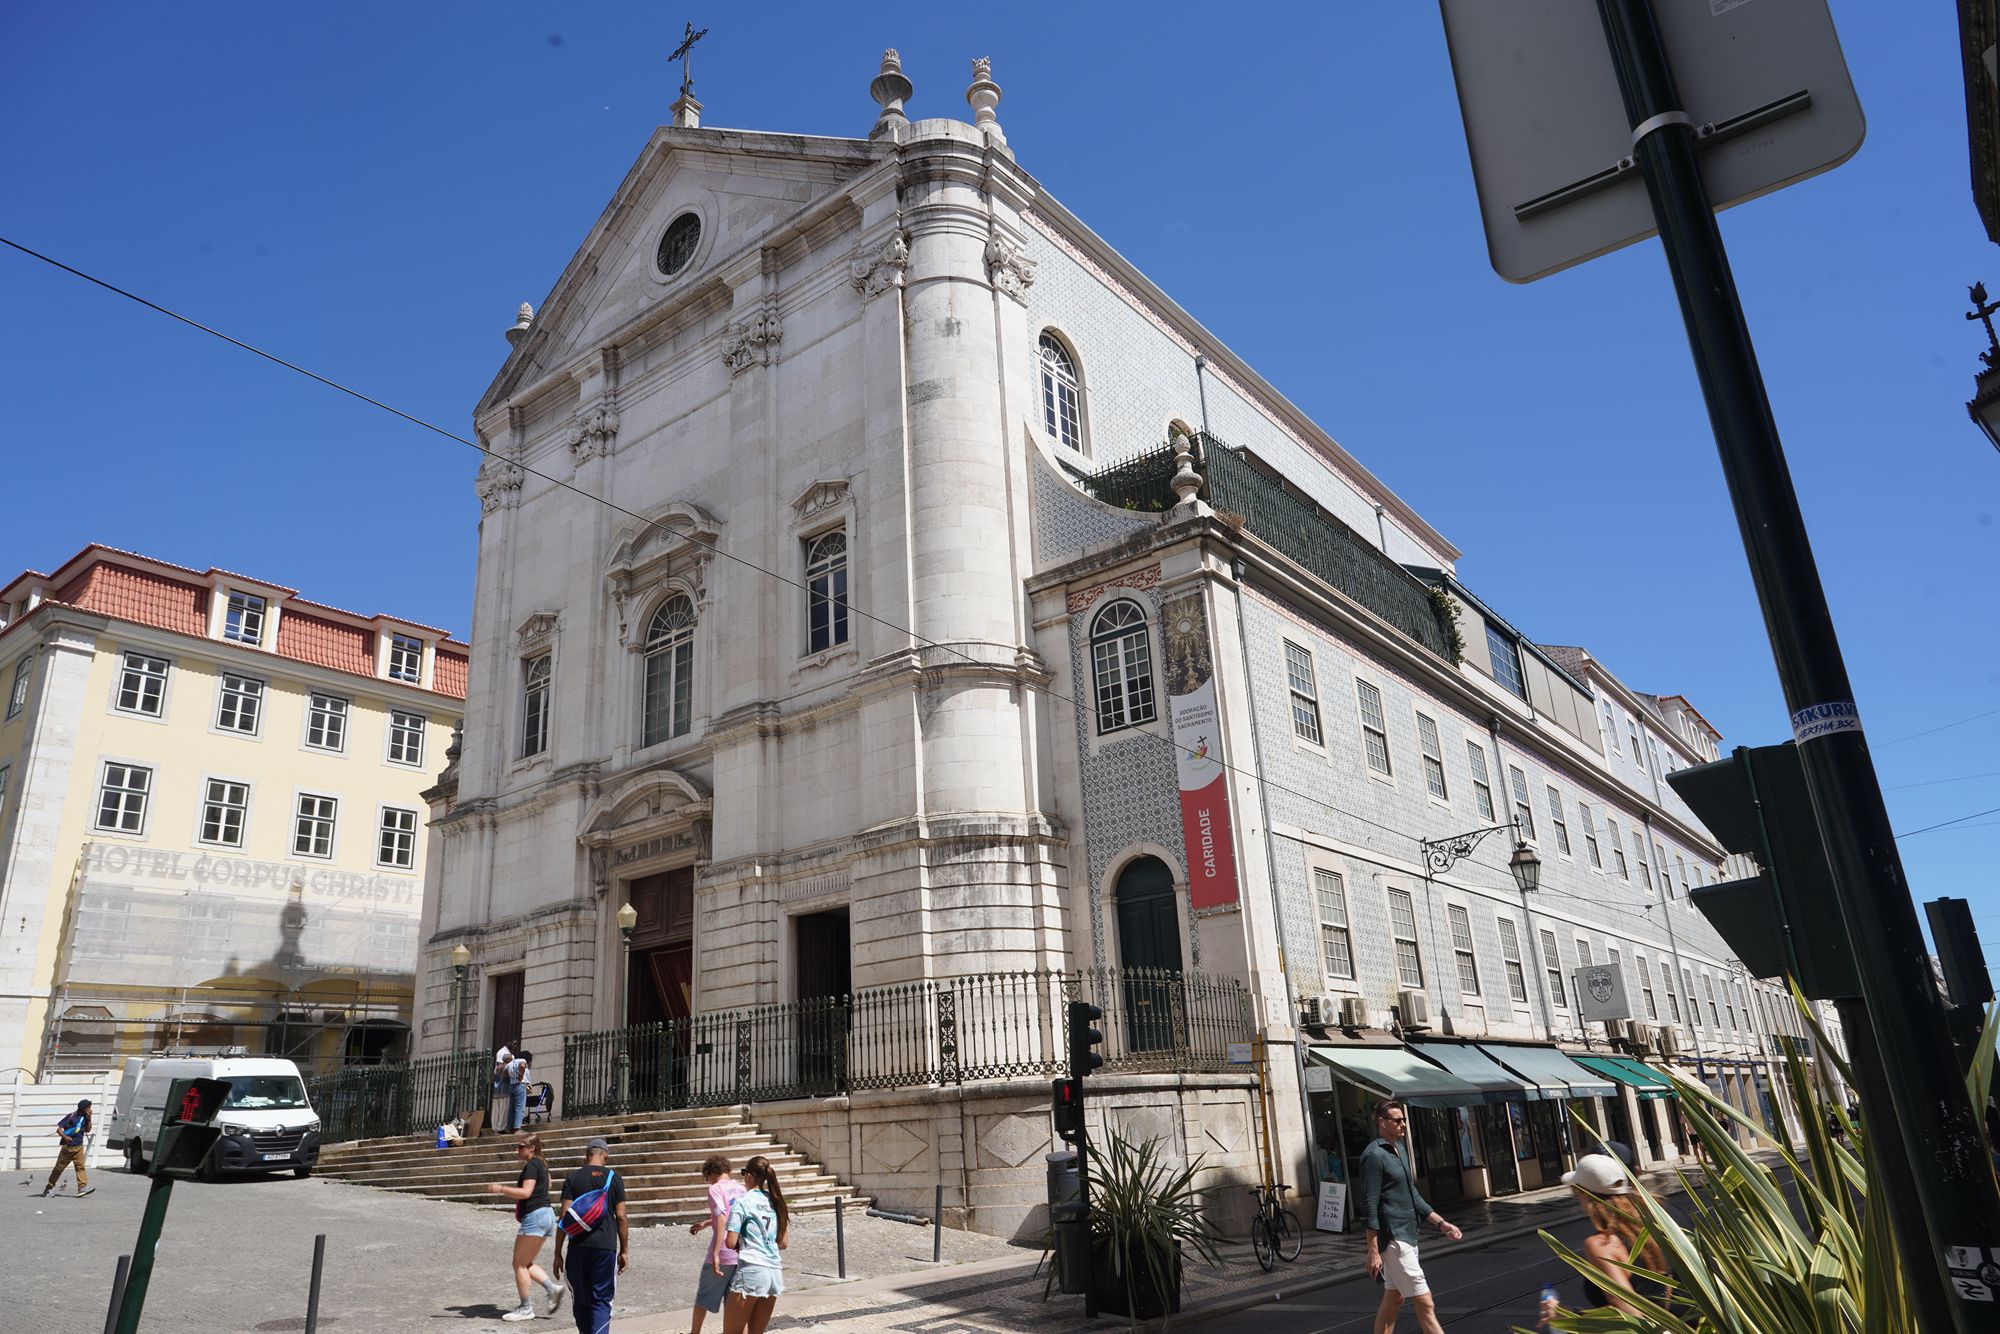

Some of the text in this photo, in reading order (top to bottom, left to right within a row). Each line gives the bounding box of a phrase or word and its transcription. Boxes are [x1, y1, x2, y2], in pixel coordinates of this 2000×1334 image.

[1179, 704, 1208, 716] ADORAÇÃO
[1177, 717, 1213, 730] SACRAMENTO
[1798, 719, 1856, 743] HERTHA BSC
[1198, 807, 1217, 879] CARIDADE
[84, 843, 415, 905] HOTEL CORPUS CHRISTI
